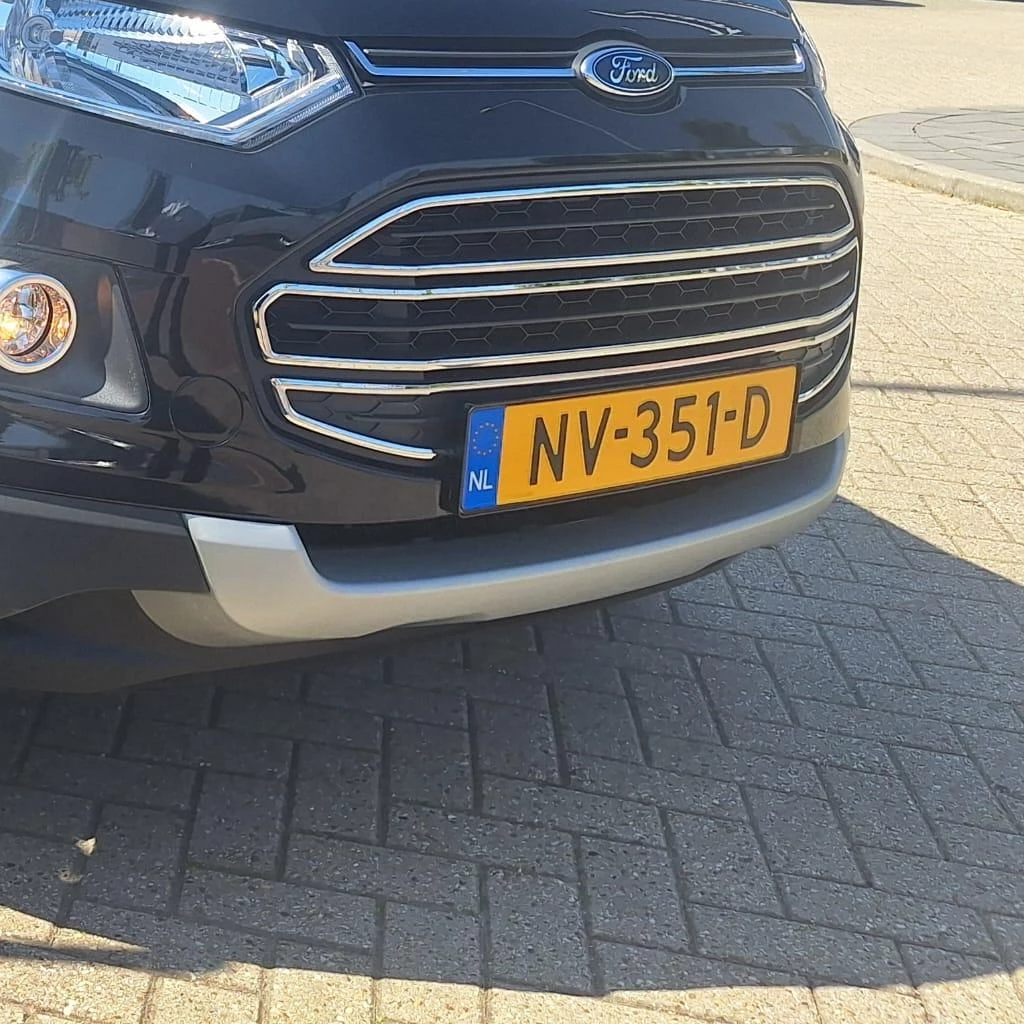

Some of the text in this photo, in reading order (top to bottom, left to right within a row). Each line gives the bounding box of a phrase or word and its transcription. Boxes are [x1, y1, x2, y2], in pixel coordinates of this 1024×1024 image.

[609, 55, 659, 84] Ford
[529, 385, 772, 487] NV-351-D
[468, 470, 493, 492] NL
